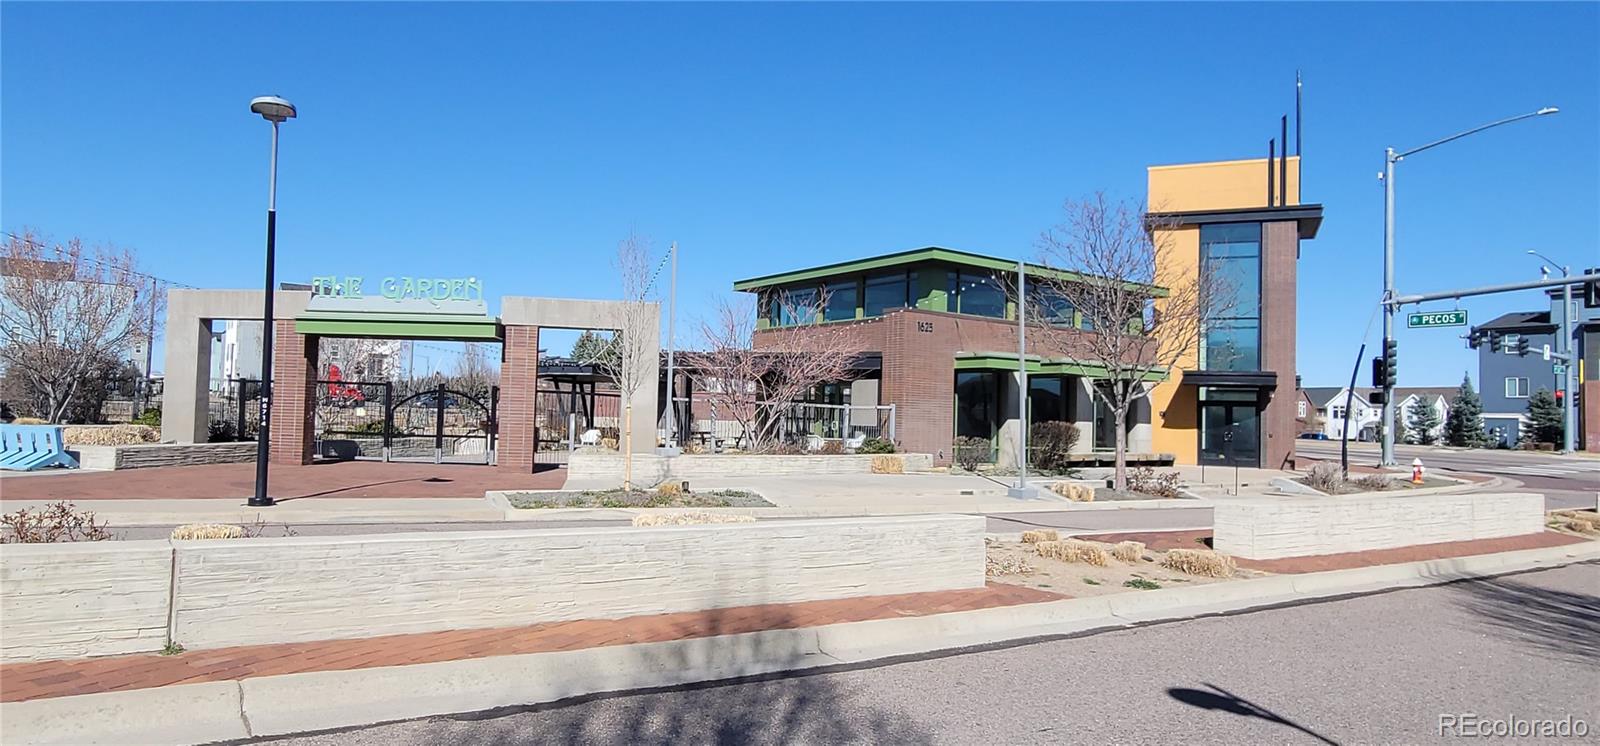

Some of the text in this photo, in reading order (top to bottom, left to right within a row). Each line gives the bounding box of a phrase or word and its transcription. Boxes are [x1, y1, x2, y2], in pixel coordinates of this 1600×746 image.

[313, 276, 483, 308] THE GARDEN
[1422, 314, 1456, 324] PECOS
[917, 321, 933, 333] 1625
